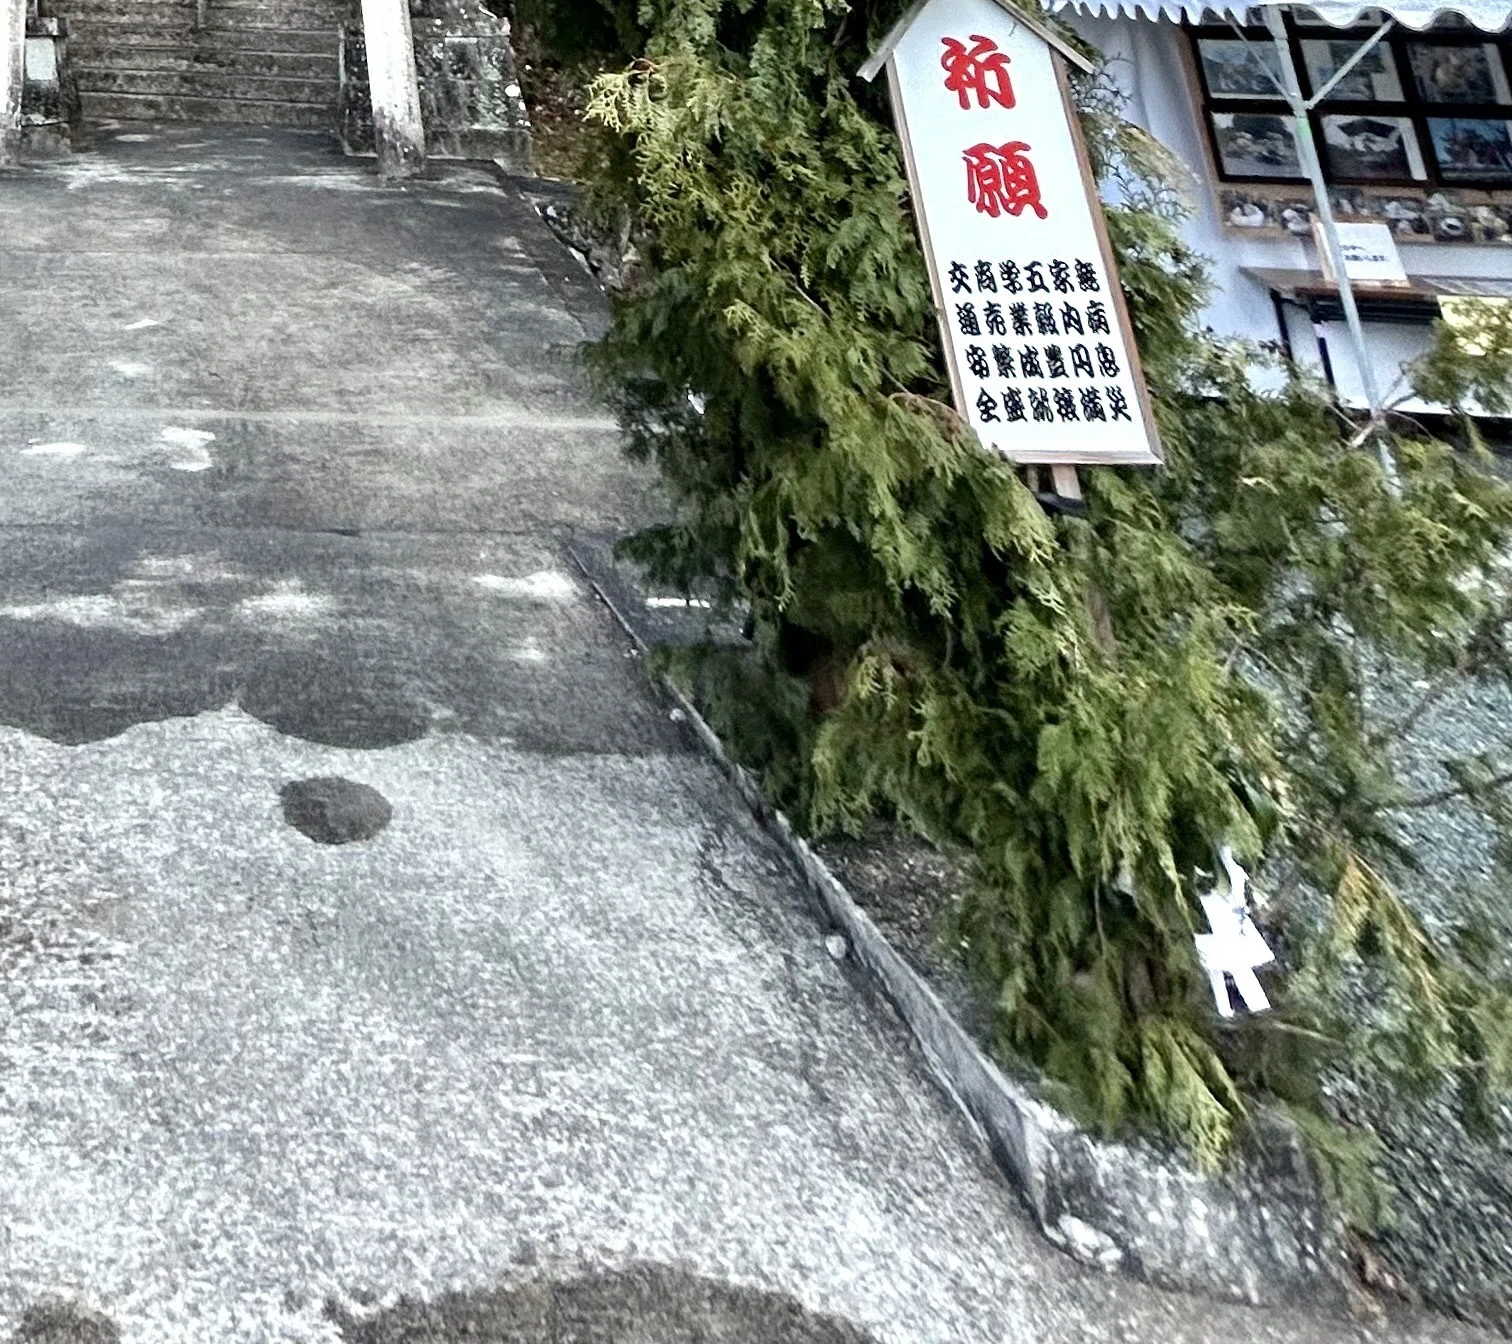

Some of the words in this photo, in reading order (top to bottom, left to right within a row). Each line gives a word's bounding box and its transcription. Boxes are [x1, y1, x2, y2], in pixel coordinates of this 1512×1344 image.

[940, 34, 1048, 220] 祈願
[947, 260, 1002, 424] 交通安全
[973, 259, 1028, 423] 商売繁盛
[998, 259, 1055, 423] 学業成就
[1047, 258, 1107, 423] 家内円満
[1074, 257, 1132, 423] 無病息災
